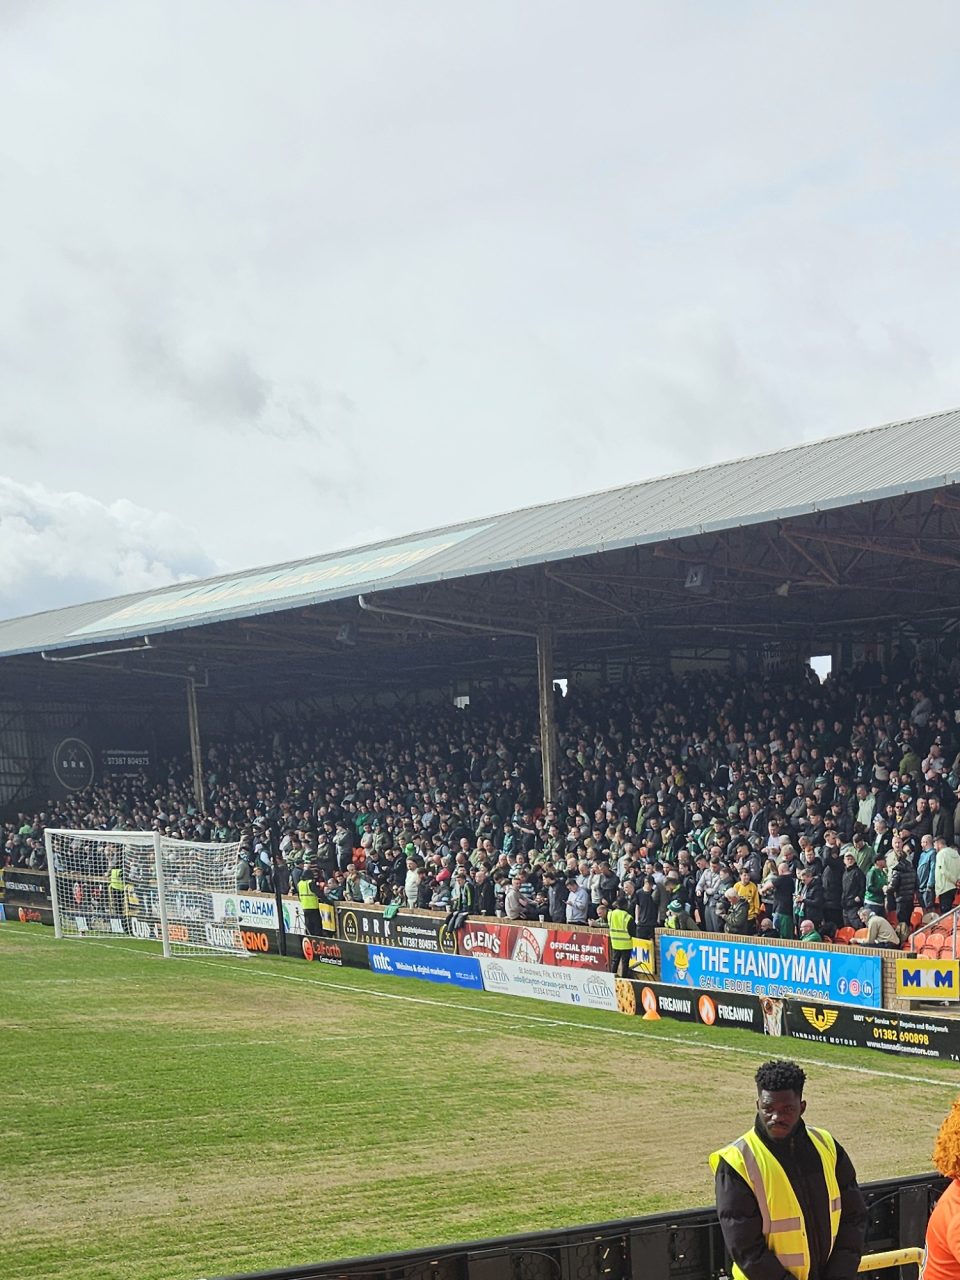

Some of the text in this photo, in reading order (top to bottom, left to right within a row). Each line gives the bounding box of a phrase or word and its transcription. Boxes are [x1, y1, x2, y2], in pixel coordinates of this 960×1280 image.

[239, 899, 274, 917] GRAHAM
[362, 917, 392, 938] BRK
[463, 931, 501, 953] GLEN'S
[550, 941, 604, 954] OFFICIAL SPIRIT
[555, 951, 599, 964] OF THE SPFL
[699, 946, 832, 986] THE HANDYMAN
[699, 975, 721, 989] CALL
[724, 979, 753, 994] EDDIE
[903, 969, 953, 989] MKM
[658, 996, 692, 1014] FIREAWAY
[717, 1004, 754, 1023] FIREAWAY
[792, 1031, 857, 1046] TANNADICE MOTORS
[873, 1027, 929, 1045] 01382 690898
[866, 1040, 940, 1057] www.tannadicemotors.com
